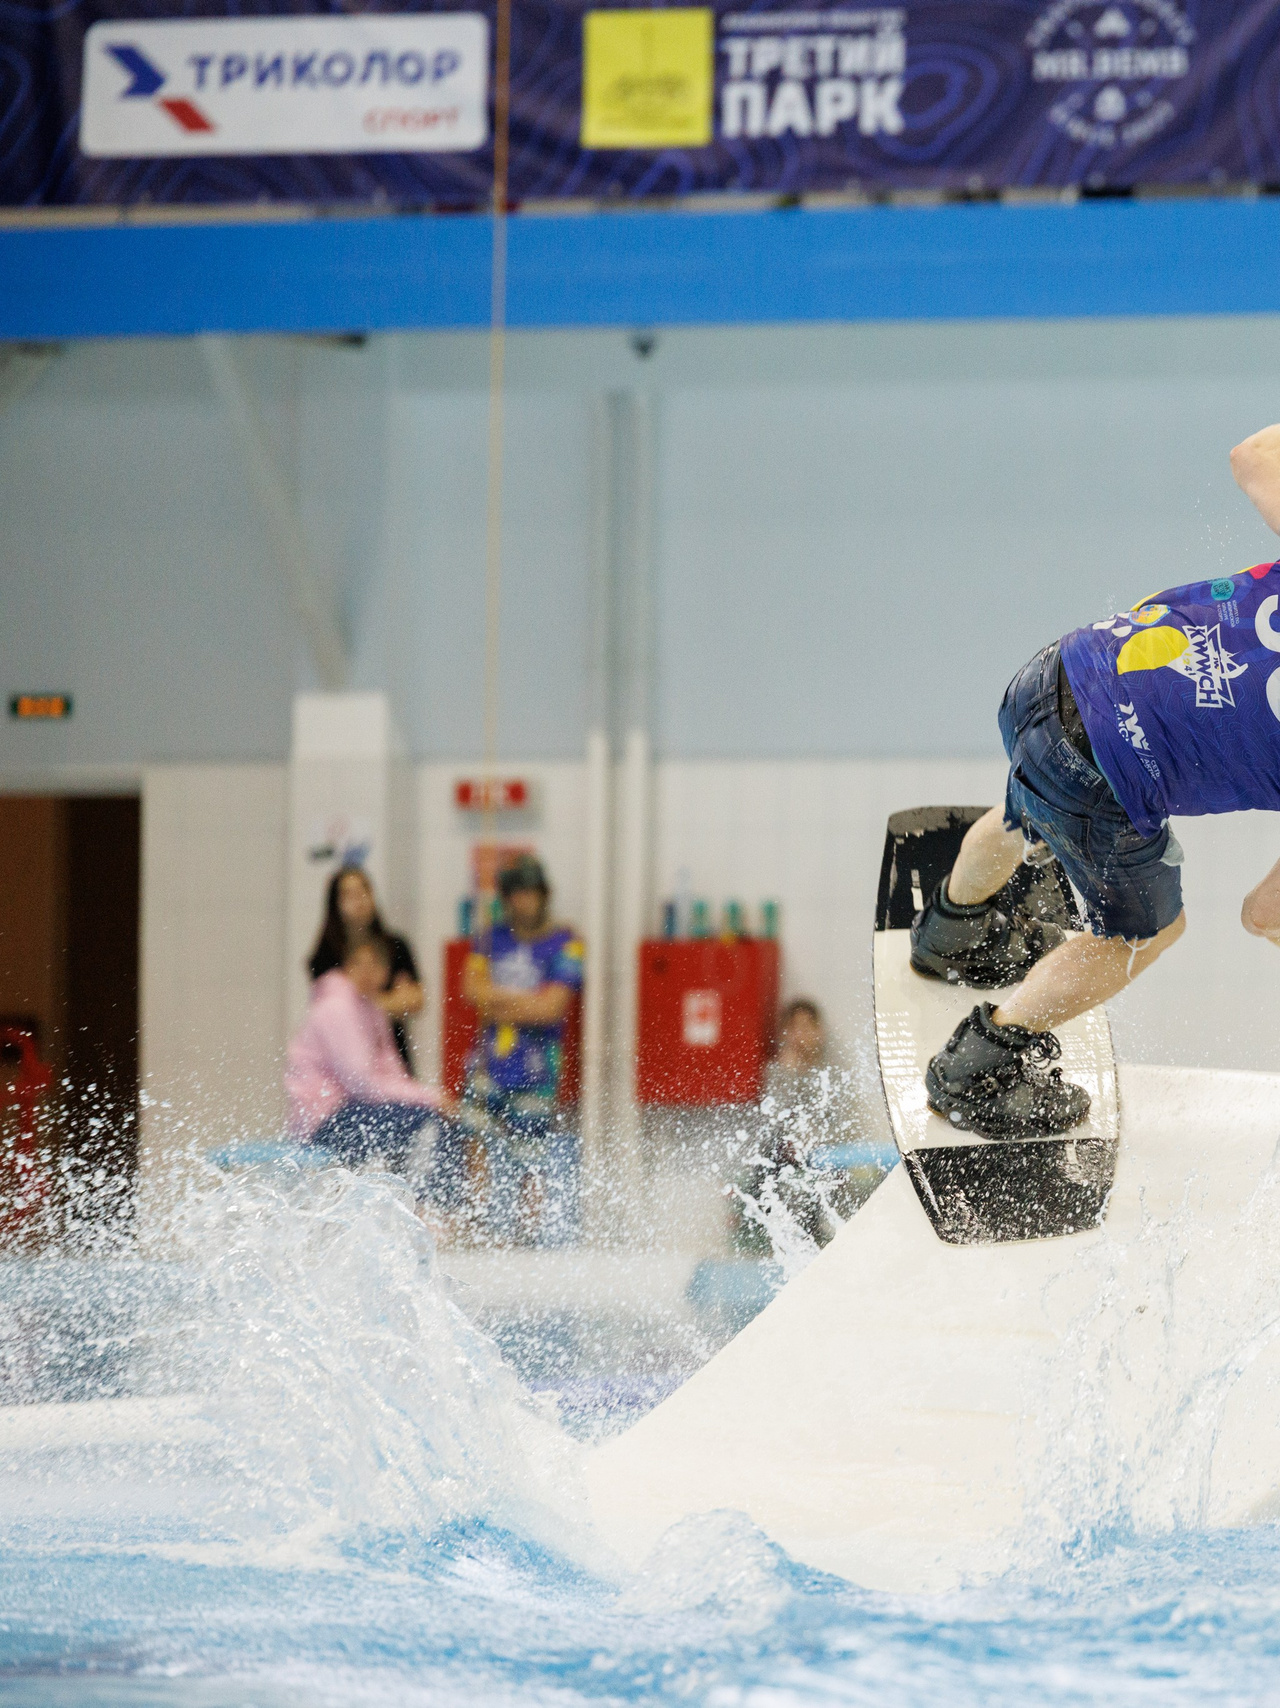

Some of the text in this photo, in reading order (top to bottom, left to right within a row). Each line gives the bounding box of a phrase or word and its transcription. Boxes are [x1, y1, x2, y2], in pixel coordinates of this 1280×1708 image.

[187, 47, 461, 89] ТРИКОЛОР
[723, 27, 906, 77] ТРЕТИЙ
[721, 78, 905, 139] ПАРК
[1187, 627, 1219, 705] KWWCH
[1150, 759, 1161, 778] СЕТЬ
